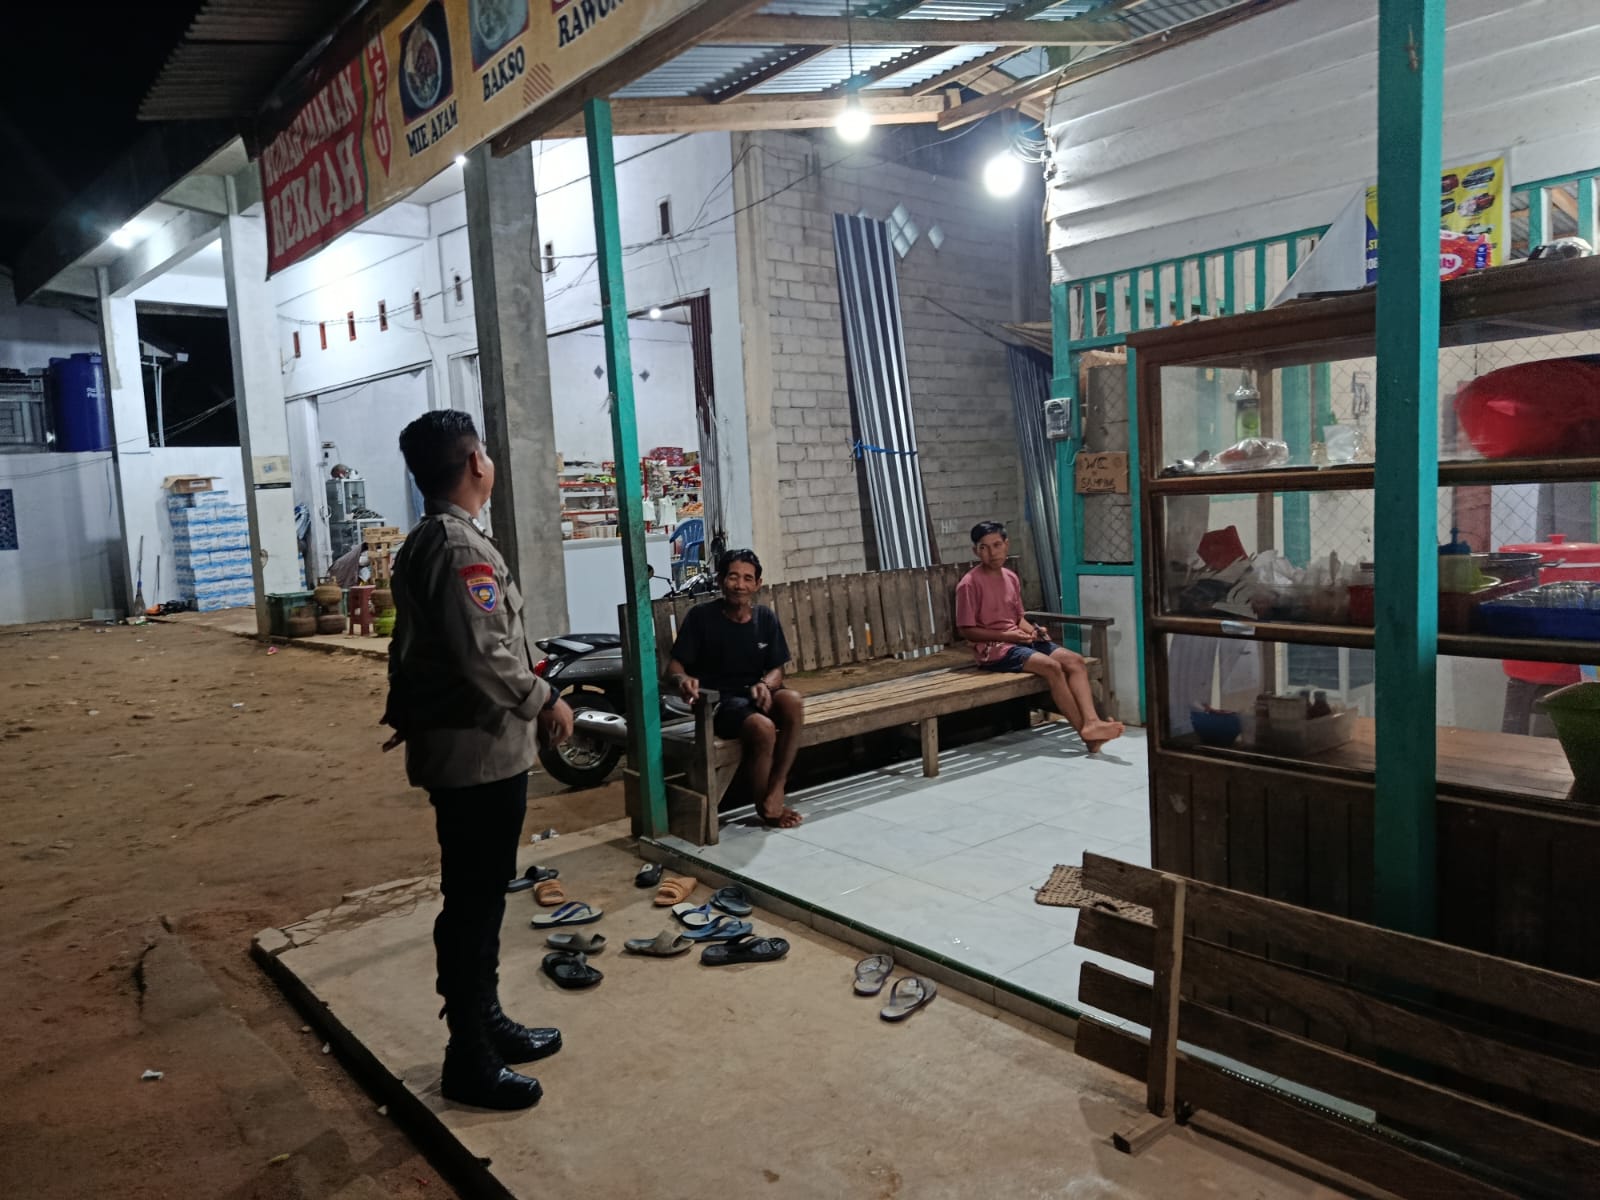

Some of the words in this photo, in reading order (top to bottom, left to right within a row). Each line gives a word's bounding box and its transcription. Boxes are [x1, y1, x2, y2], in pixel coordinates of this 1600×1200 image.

[302, 64, 358, 148] MAKAN
[482, 46, 525, 101] BAKSO
[406, 124, 429, 157] MIE
[431, 101, 458, 145] AYAM
[270, 132, 363, 257] BERKAH
